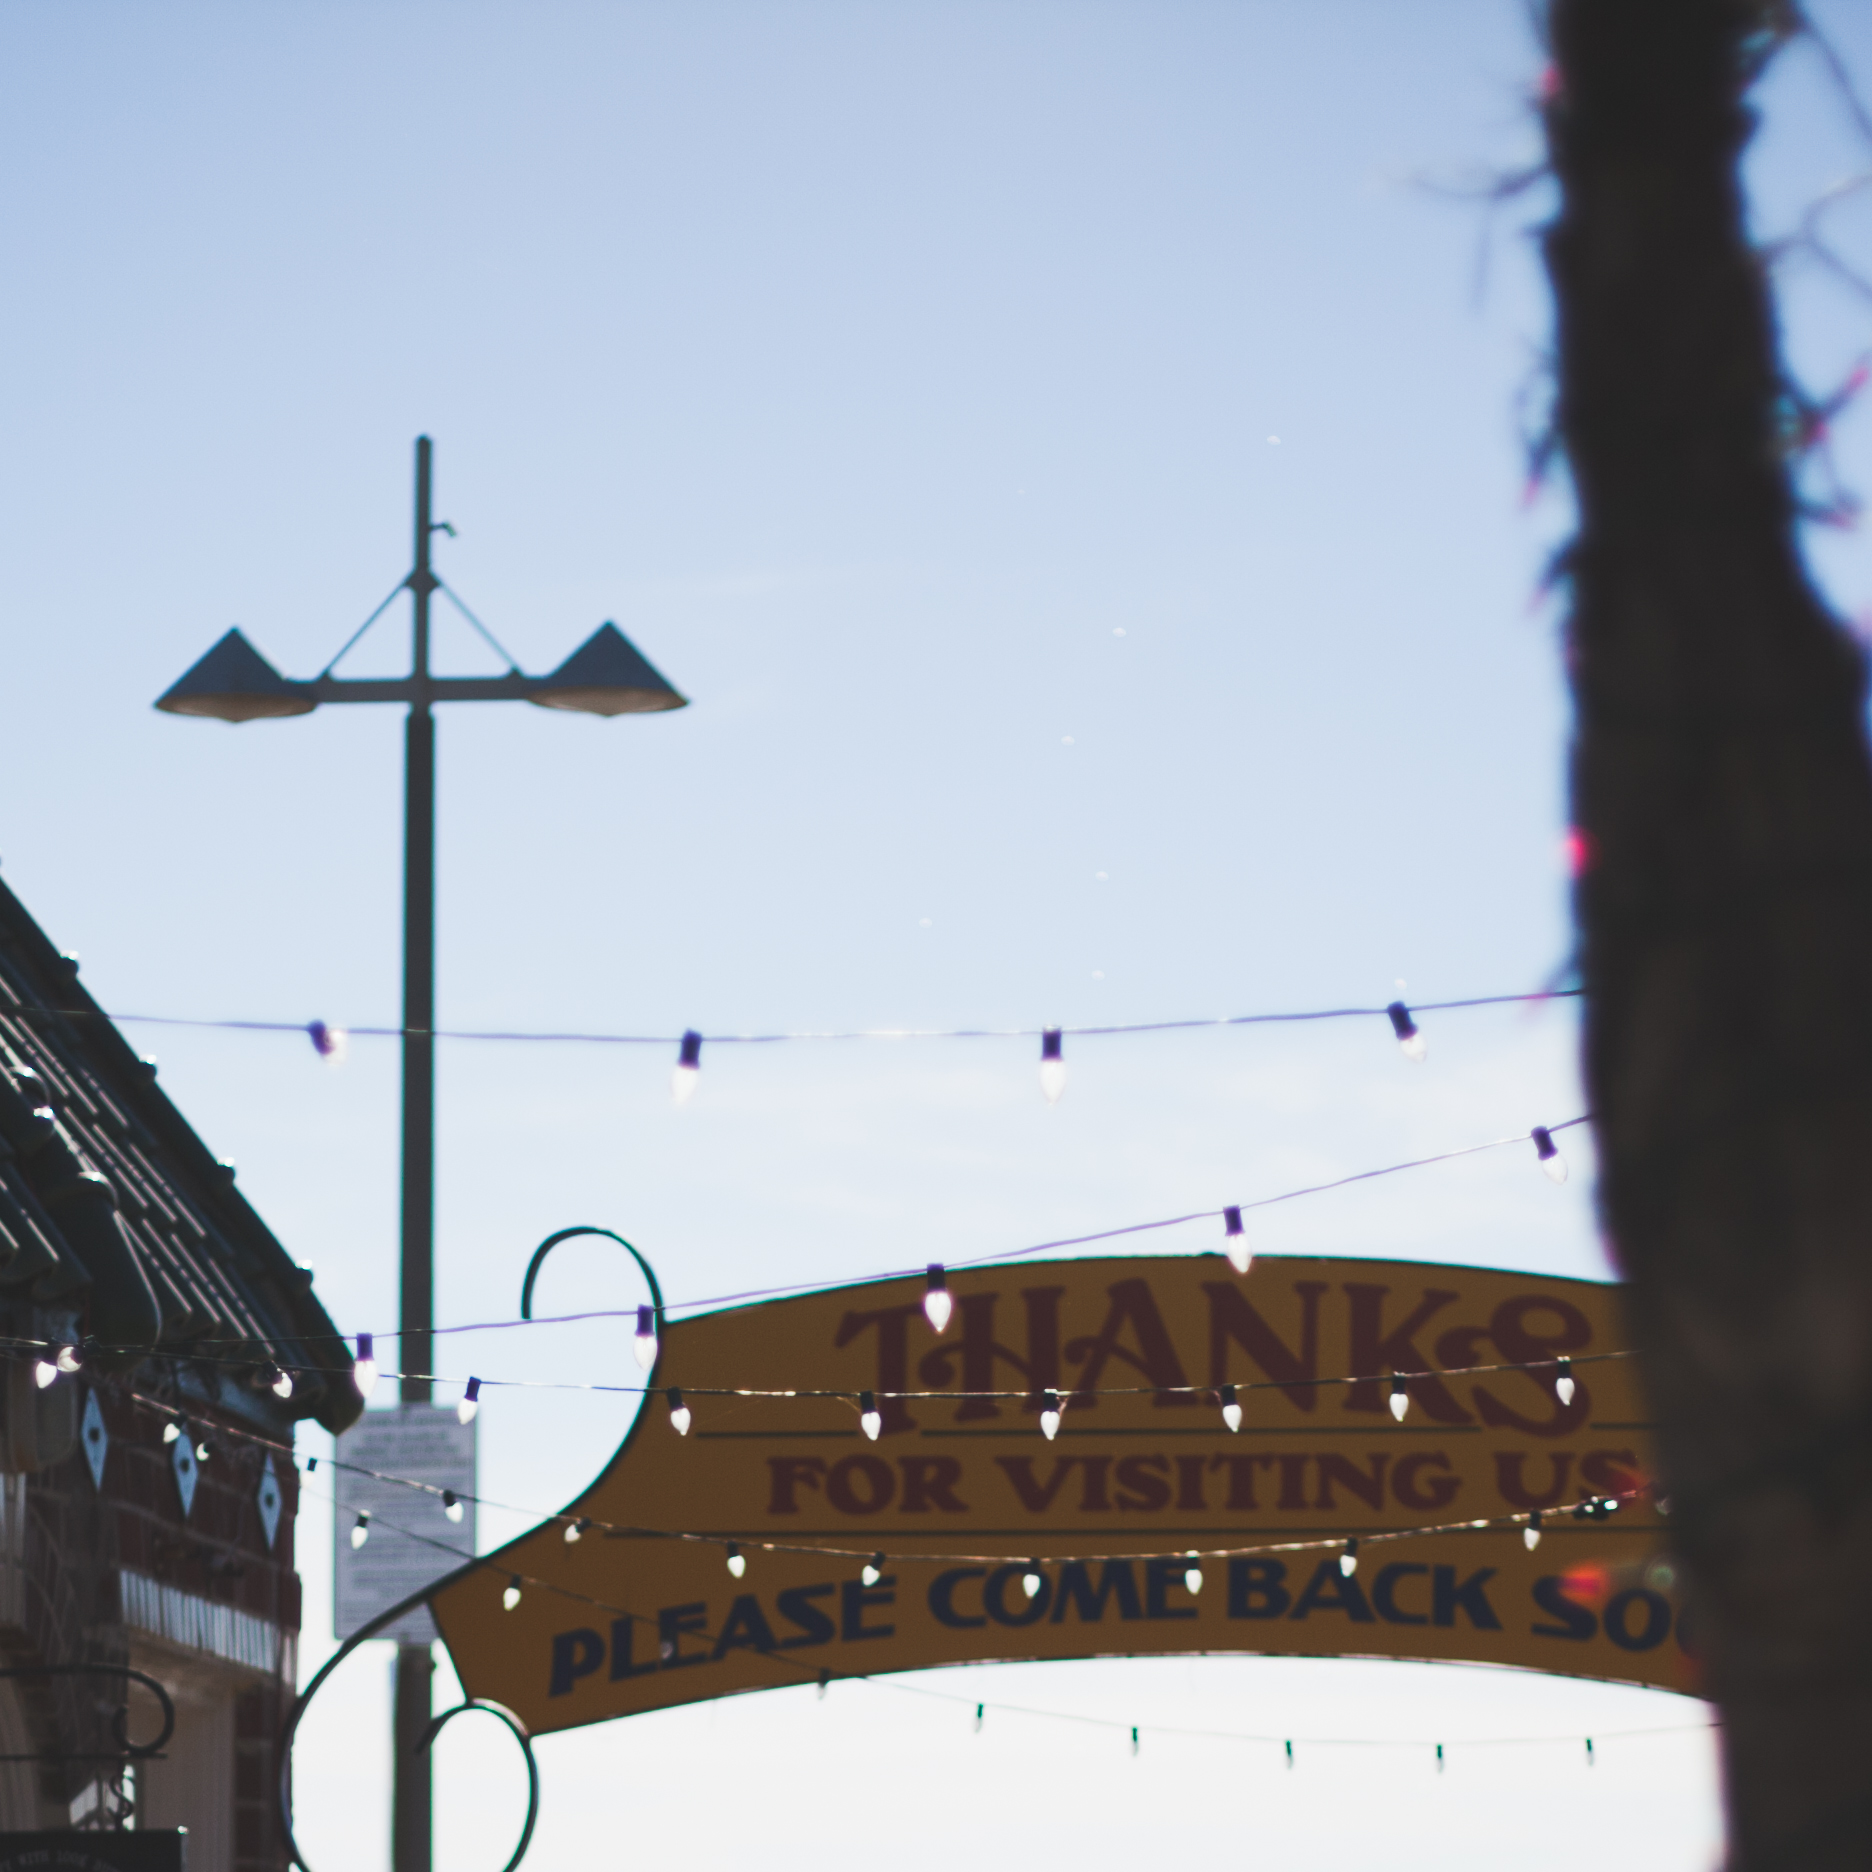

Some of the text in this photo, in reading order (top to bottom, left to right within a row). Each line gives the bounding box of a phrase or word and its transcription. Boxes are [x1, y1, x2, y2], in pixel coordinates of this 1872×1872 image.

[837, 1280, 1593, 1438] THANKS
[768, 1455, 967, 1515] FOR
[995, 1453, 1461, 1514] VISITING
[550, 1577, 896, 1697] PLEASE
[928, 1557, 1200, 1628] COME
[1228, 1558, 1501, 1629] BACK
